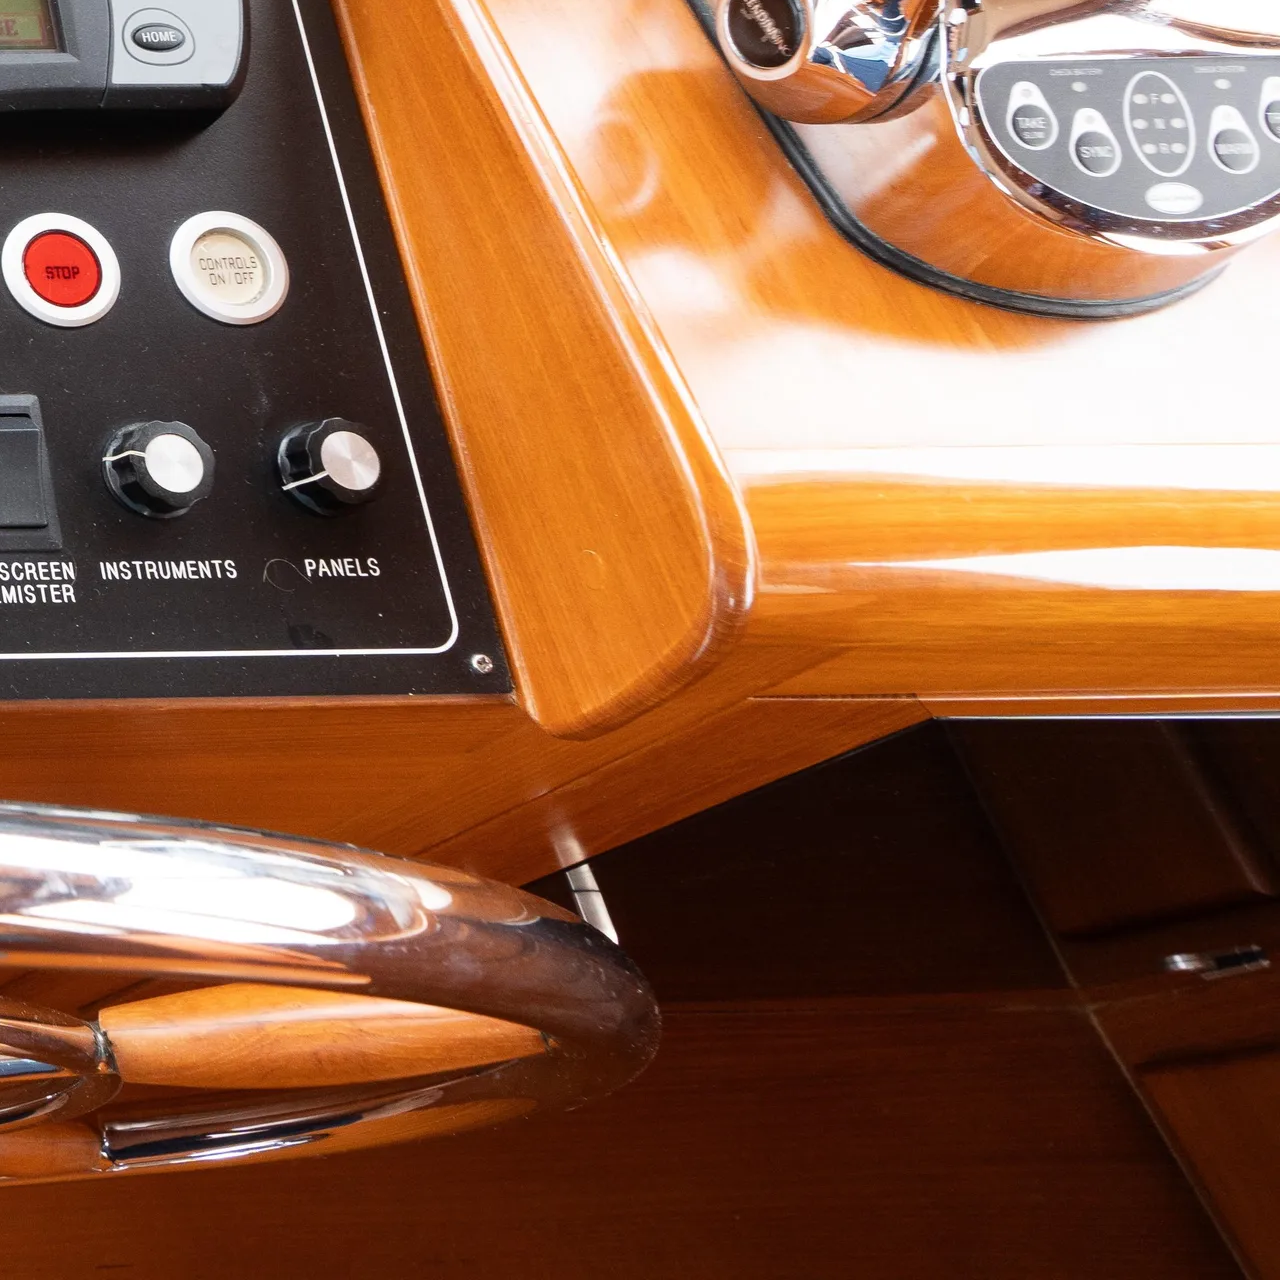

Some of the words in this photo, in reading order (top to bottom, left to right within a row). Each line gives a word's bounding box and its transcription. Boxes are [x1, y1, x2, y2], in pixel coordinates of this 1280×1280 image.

[141, 31, 177, 43] HOME
[199, 256, 257, 270] CONTROLS
[45, 265, 80, 281] STOP
[100, 560, 238, 580] INSTRUMENTS
[304, 558, 381, 577] PANELS
